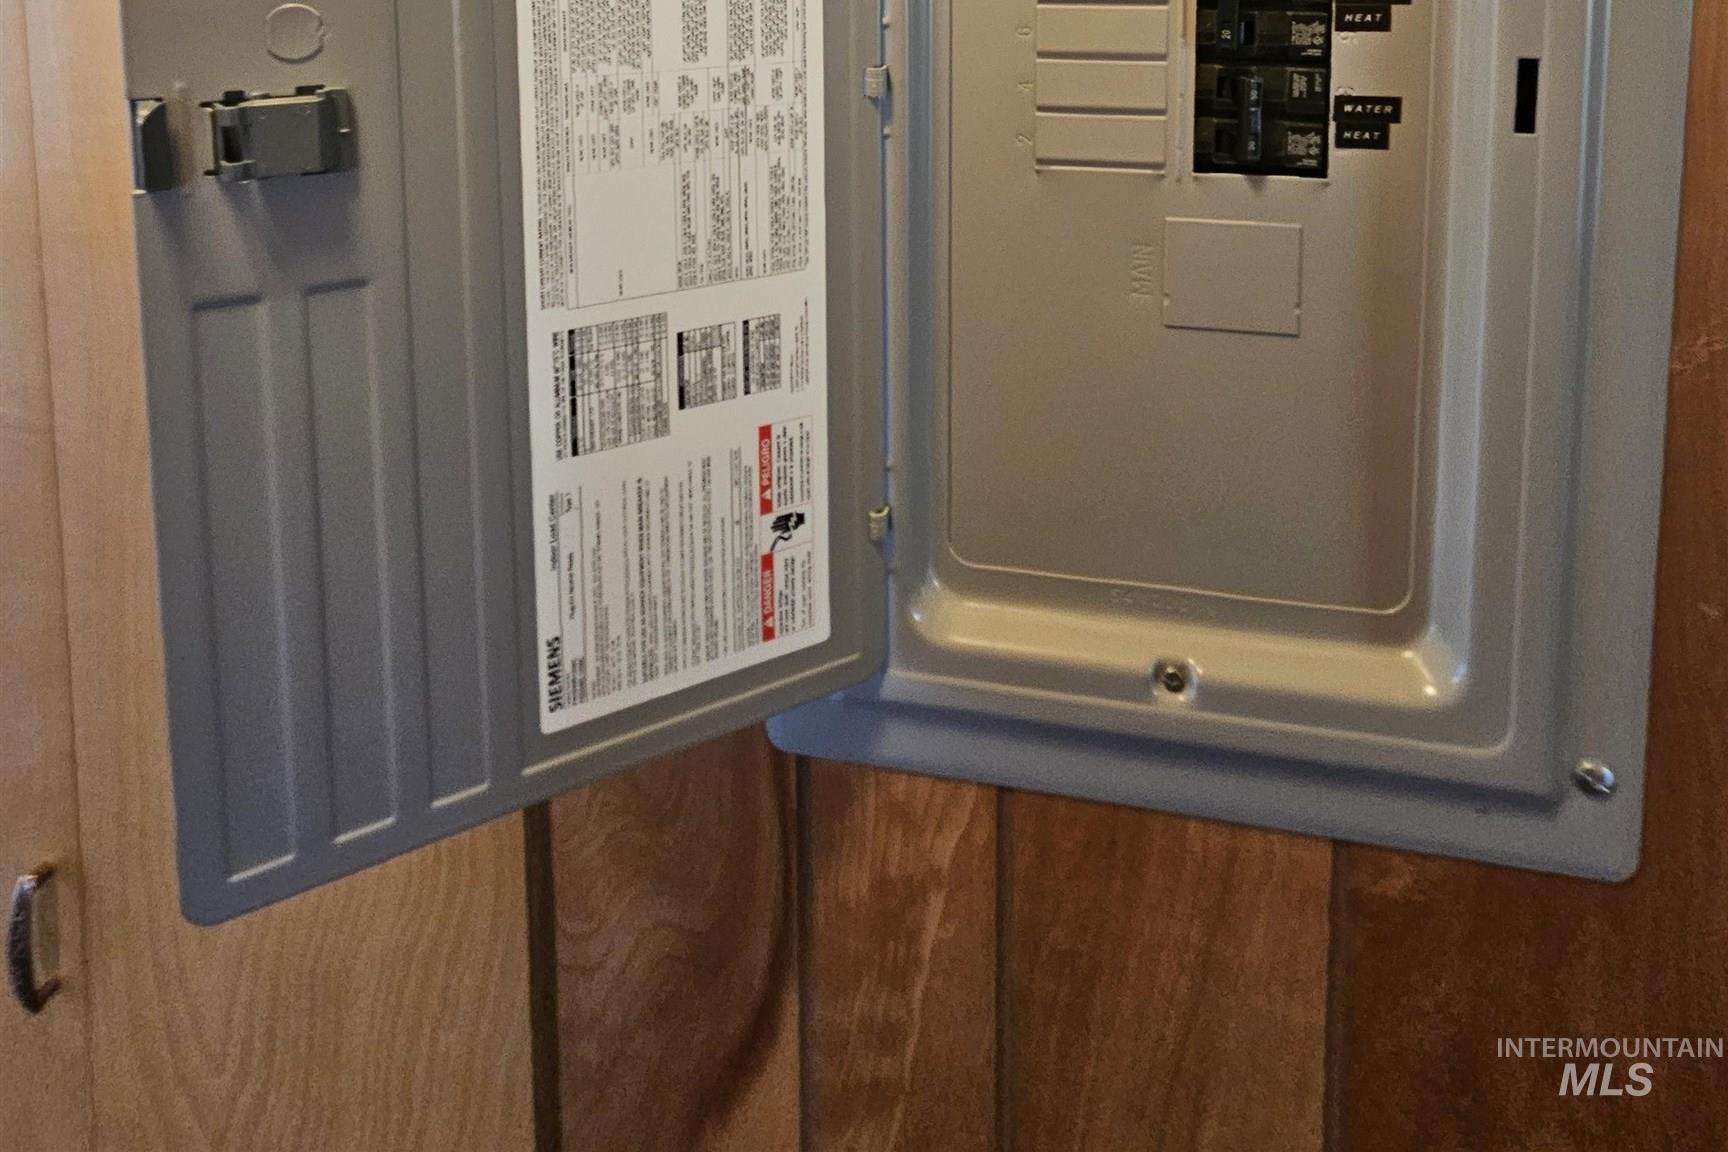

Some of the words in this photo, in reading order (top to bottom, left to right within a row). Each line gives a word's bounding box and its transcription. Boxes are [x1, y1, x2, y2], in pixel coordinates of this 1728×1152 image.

[1344, 13, 1383, 22] HEAT
[1343, 104, 1393, 113] WATER
[1343, 131, 1381, 140] HEAT
[1130, 243, 1154, 298] MAIN
[760, 438, 770, 487] PELIGRO
[763, 569, 772, 615] DANGER
[546, 636, 562, 713] SIEMENS
